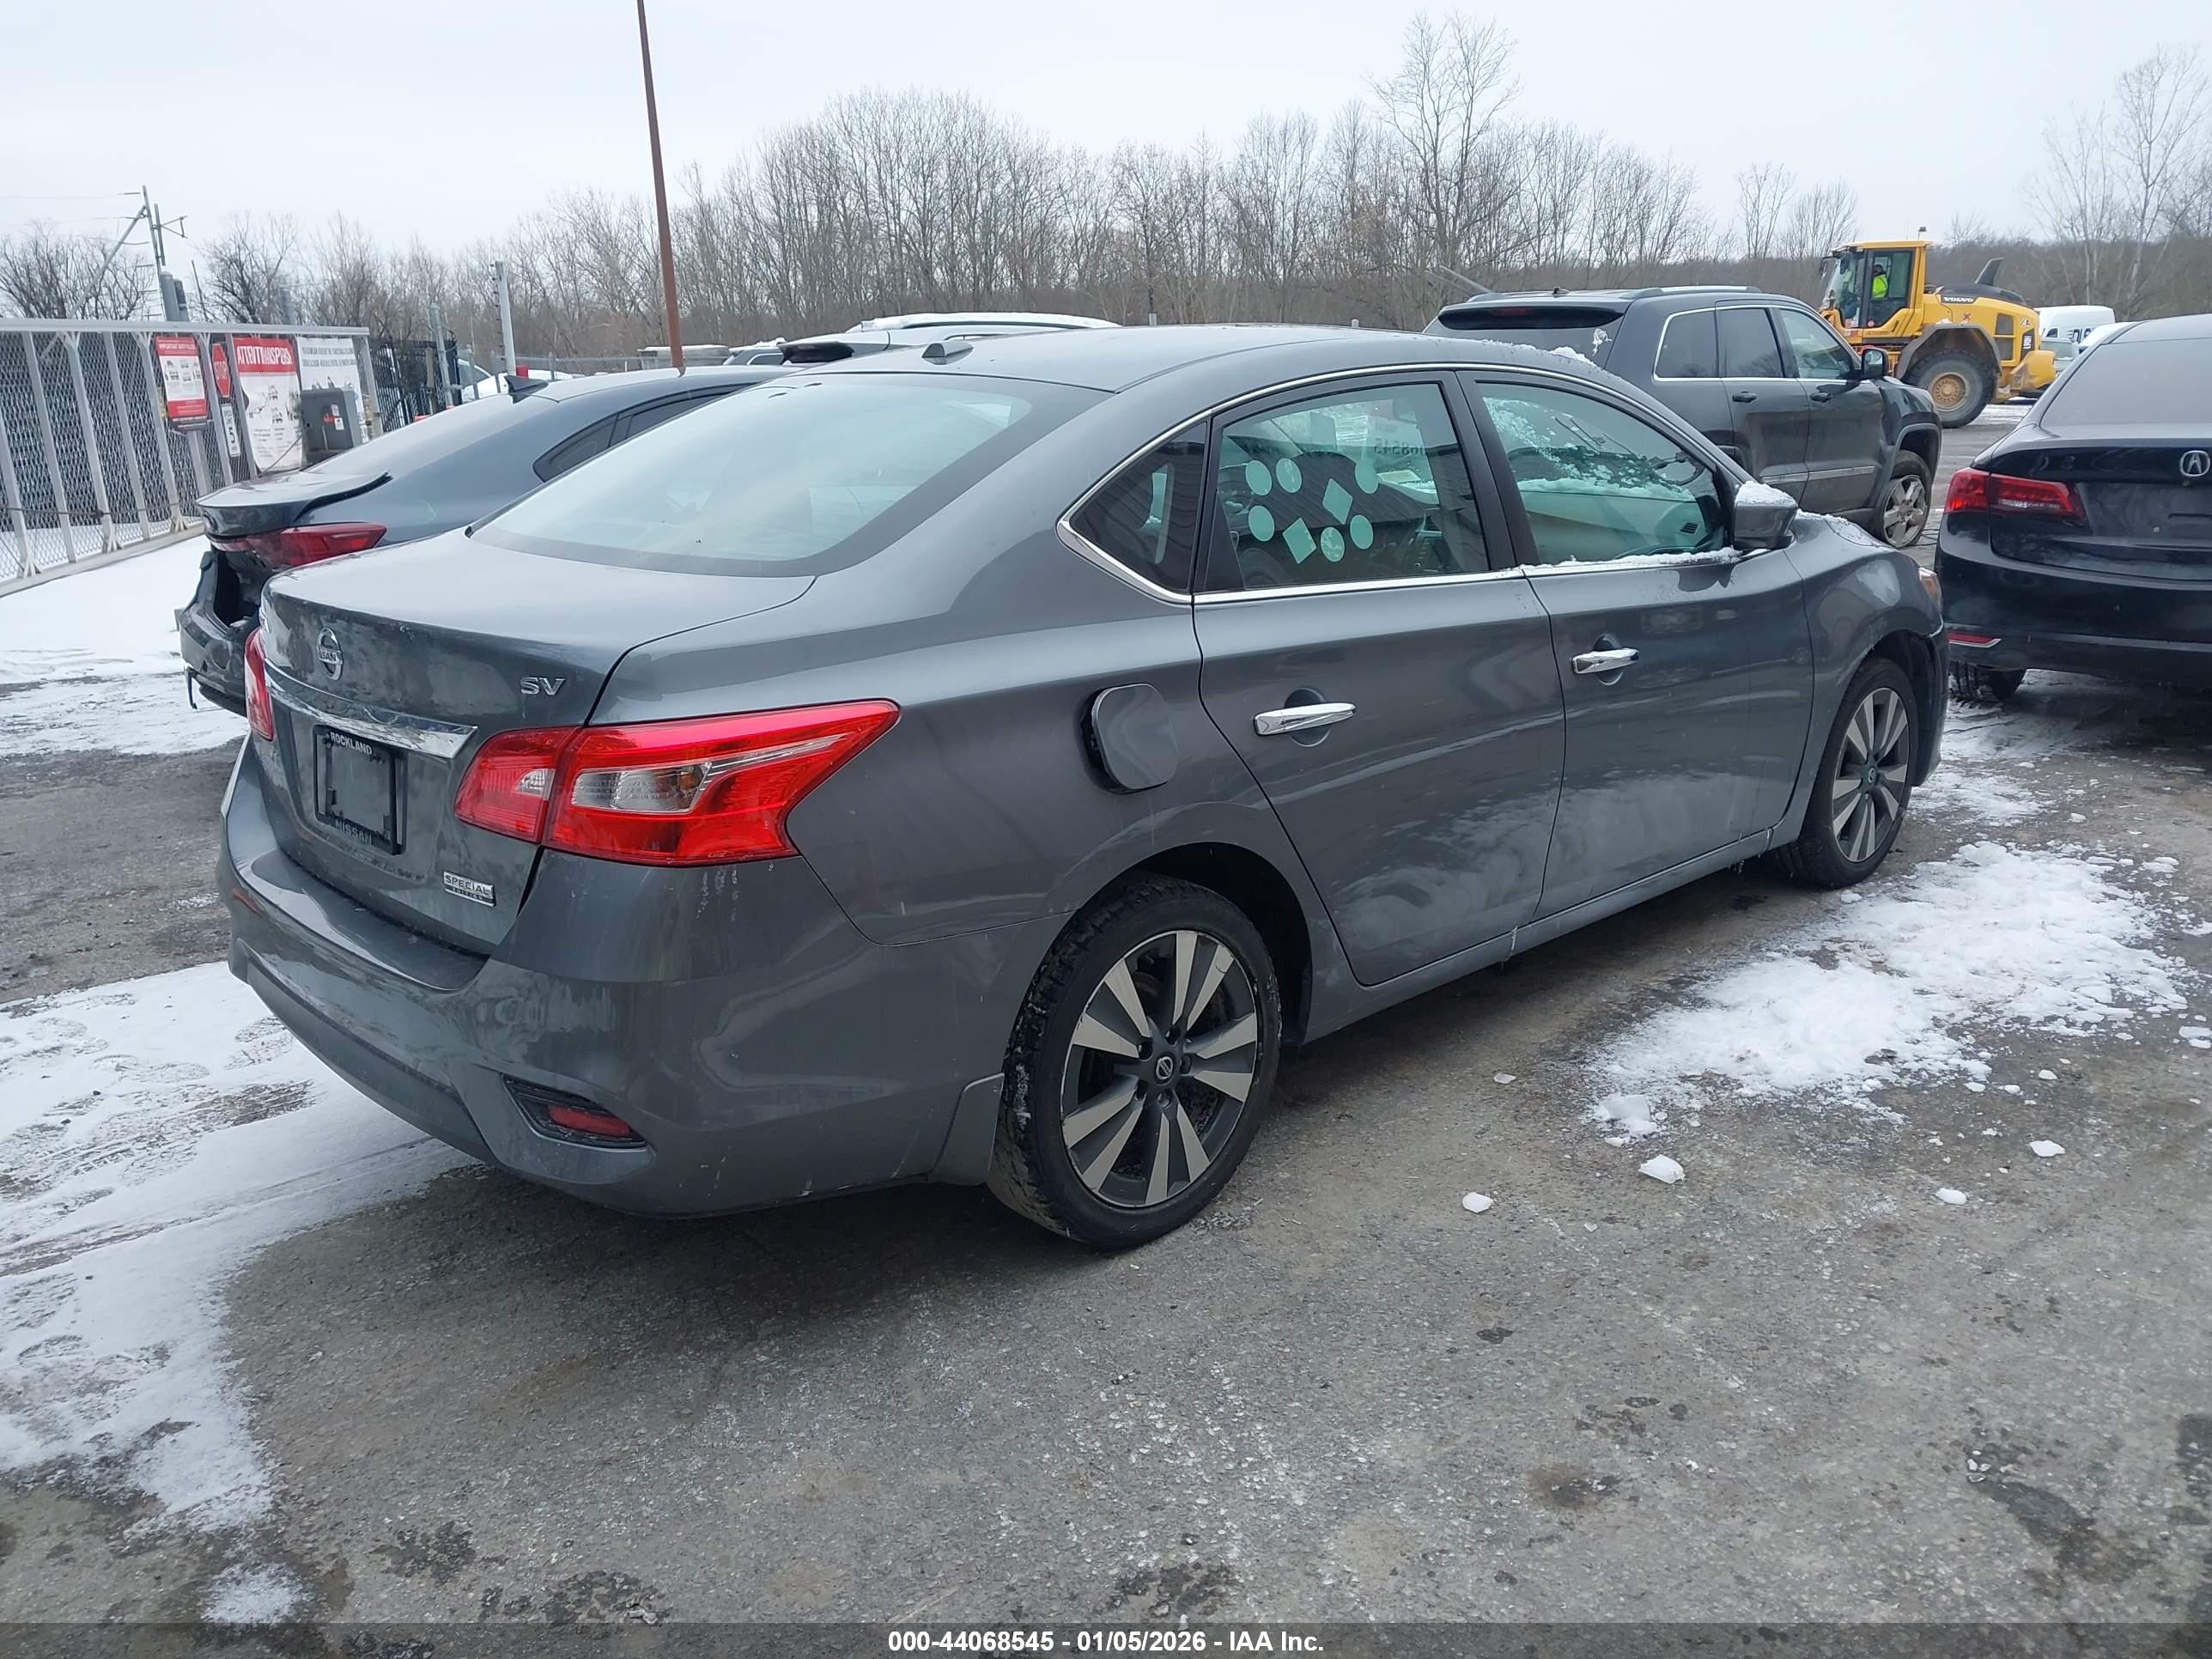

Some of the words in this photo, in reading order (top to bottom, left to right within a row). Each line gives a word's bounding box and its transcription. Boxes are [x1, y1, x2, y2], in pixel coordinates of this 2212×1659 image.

[228, 426, 235, 443] 5
[520, 677, 566, 696] SV
[330, 732, 373, 756] ROCKLAND
[334, 817, 373, 846] NISSAN
[446, 874, 490, 896] SPECIAL
